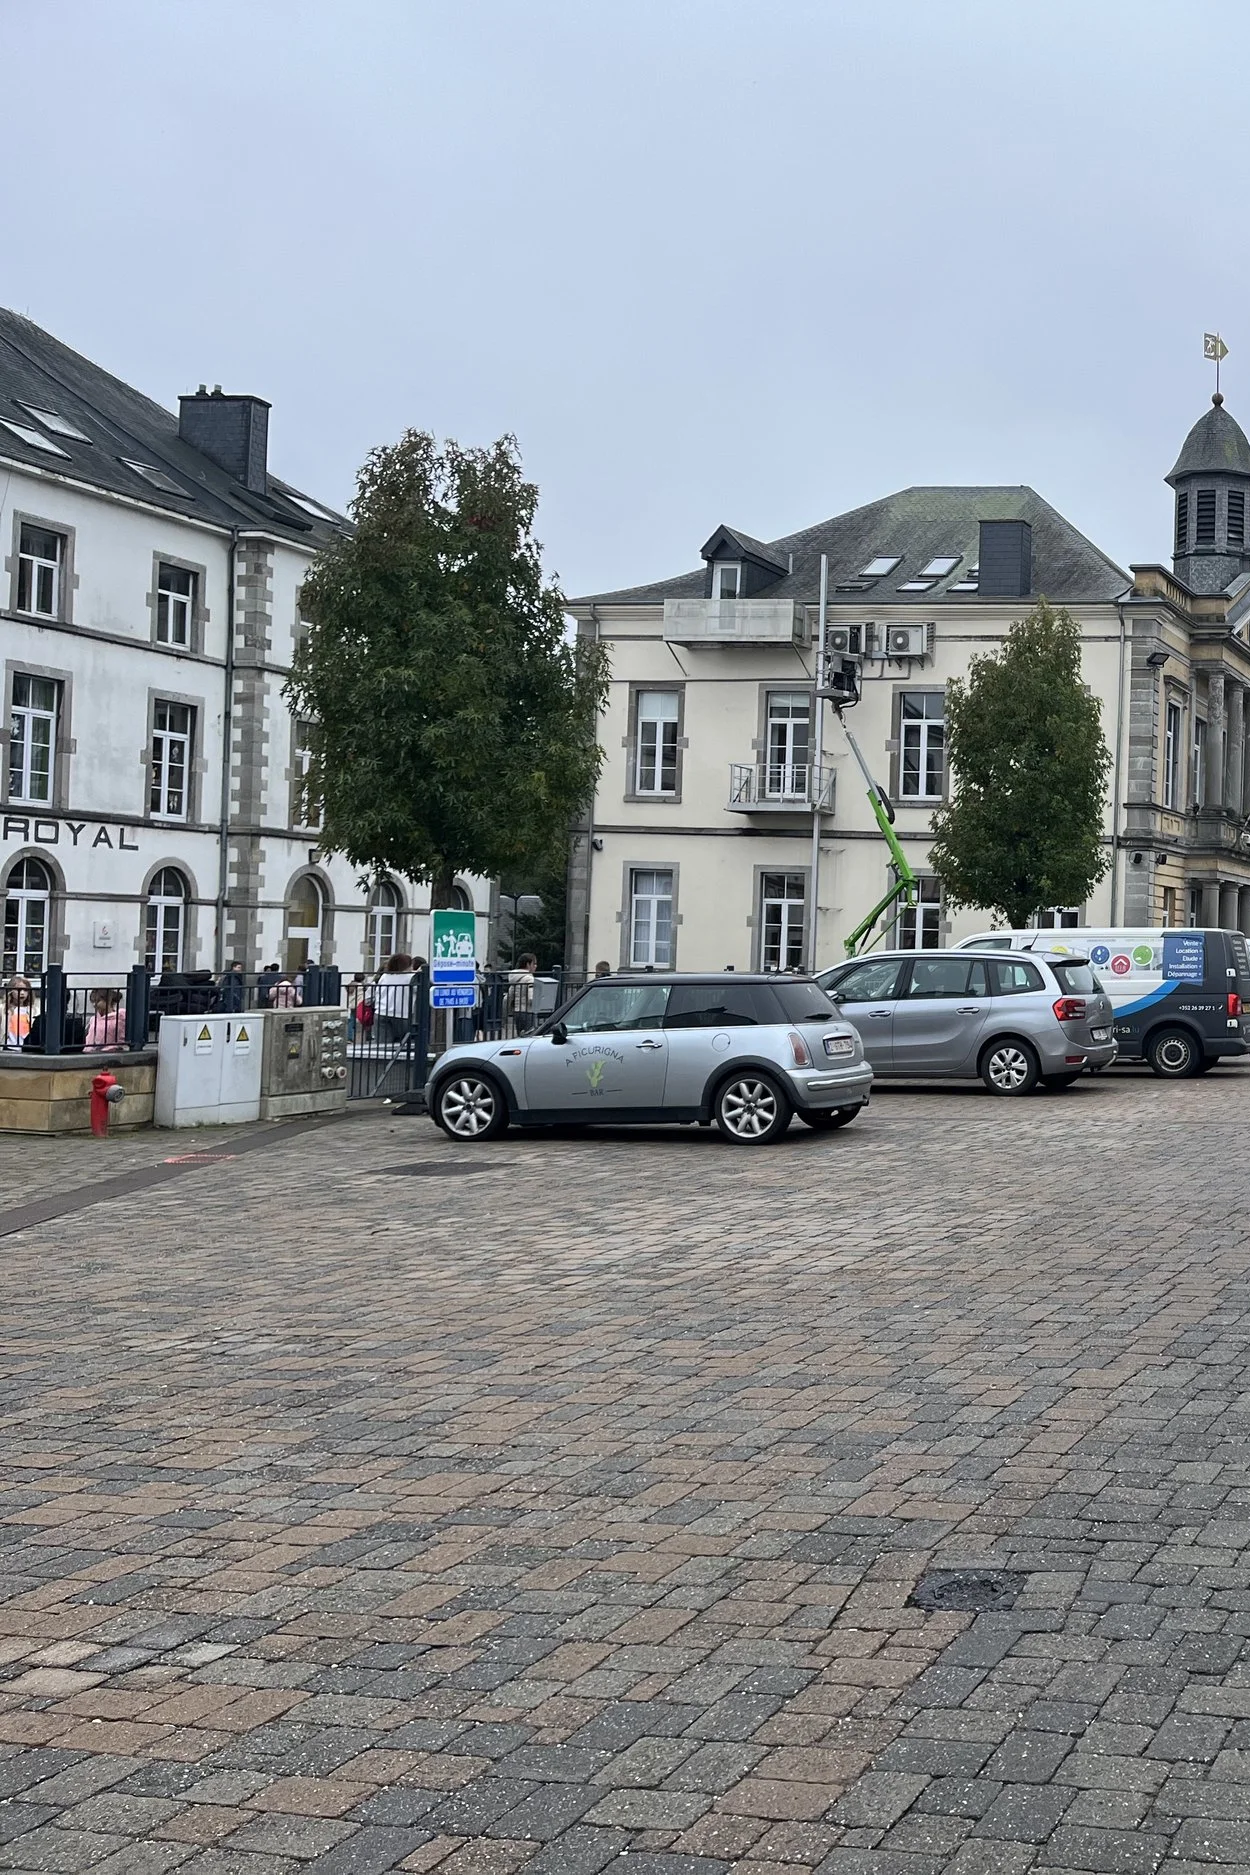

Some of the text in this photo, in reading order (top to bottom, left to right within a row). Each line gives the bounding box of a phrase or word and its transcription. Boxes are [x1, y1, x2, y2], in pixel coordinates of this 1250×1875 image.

[3, 816, 139, 851] ROYAL
[1167, 970, 1198, 978] Dépannage
[590, 1088, 605, 1097] BAR
